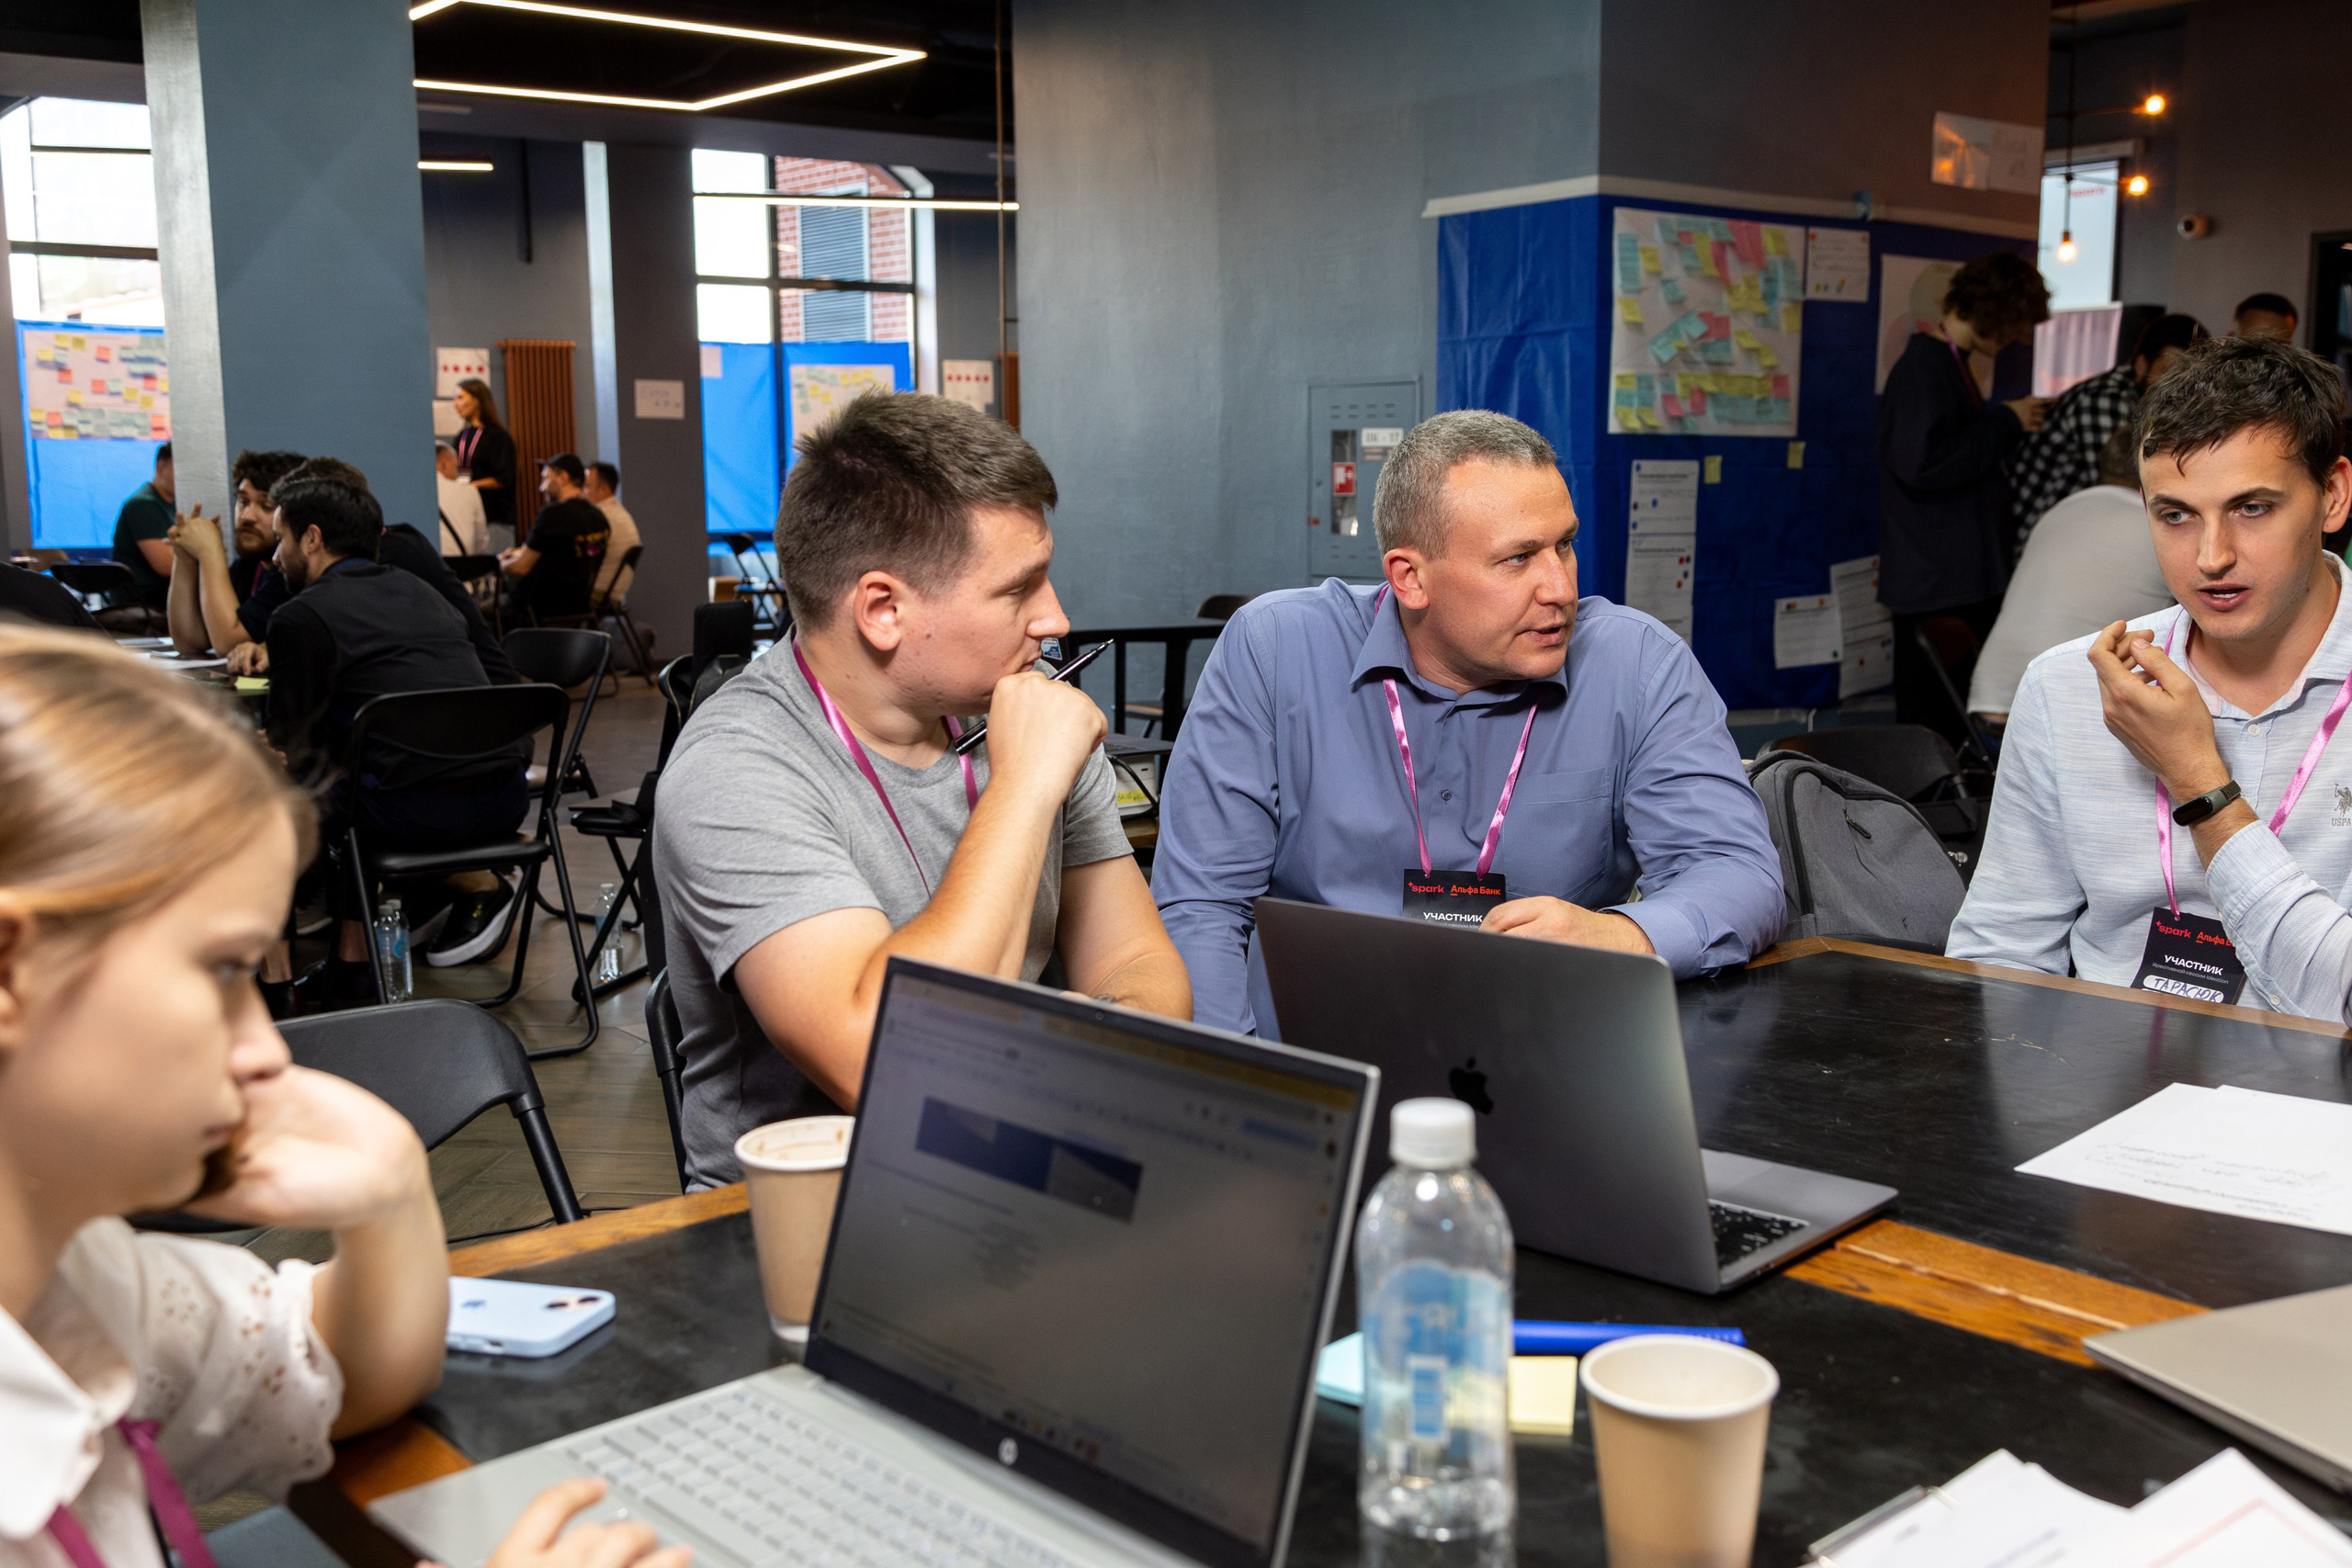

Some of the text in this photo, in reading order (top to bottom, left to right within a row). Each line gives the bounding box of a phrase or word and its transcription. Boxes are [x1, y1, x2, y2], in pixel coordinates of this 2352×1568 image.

[2331, 818, 2352, 827] USPA
[1411, 885, 1444, 894] spark
[1451, 885, 1501, 896] Альфа Банк
[1423, 912, 1483, 923] УЧАСТНИК
[2158, 925, 2191, 938] spark
[2196, 931, 2225, 945] Альфа
[2165, 954, 2223, 976] УЧАСТНИК
[2152, 962, 2229, 985] Креативной сессии Ideation
[2154, 977, 2222, 1002] ТАРАСЮК
